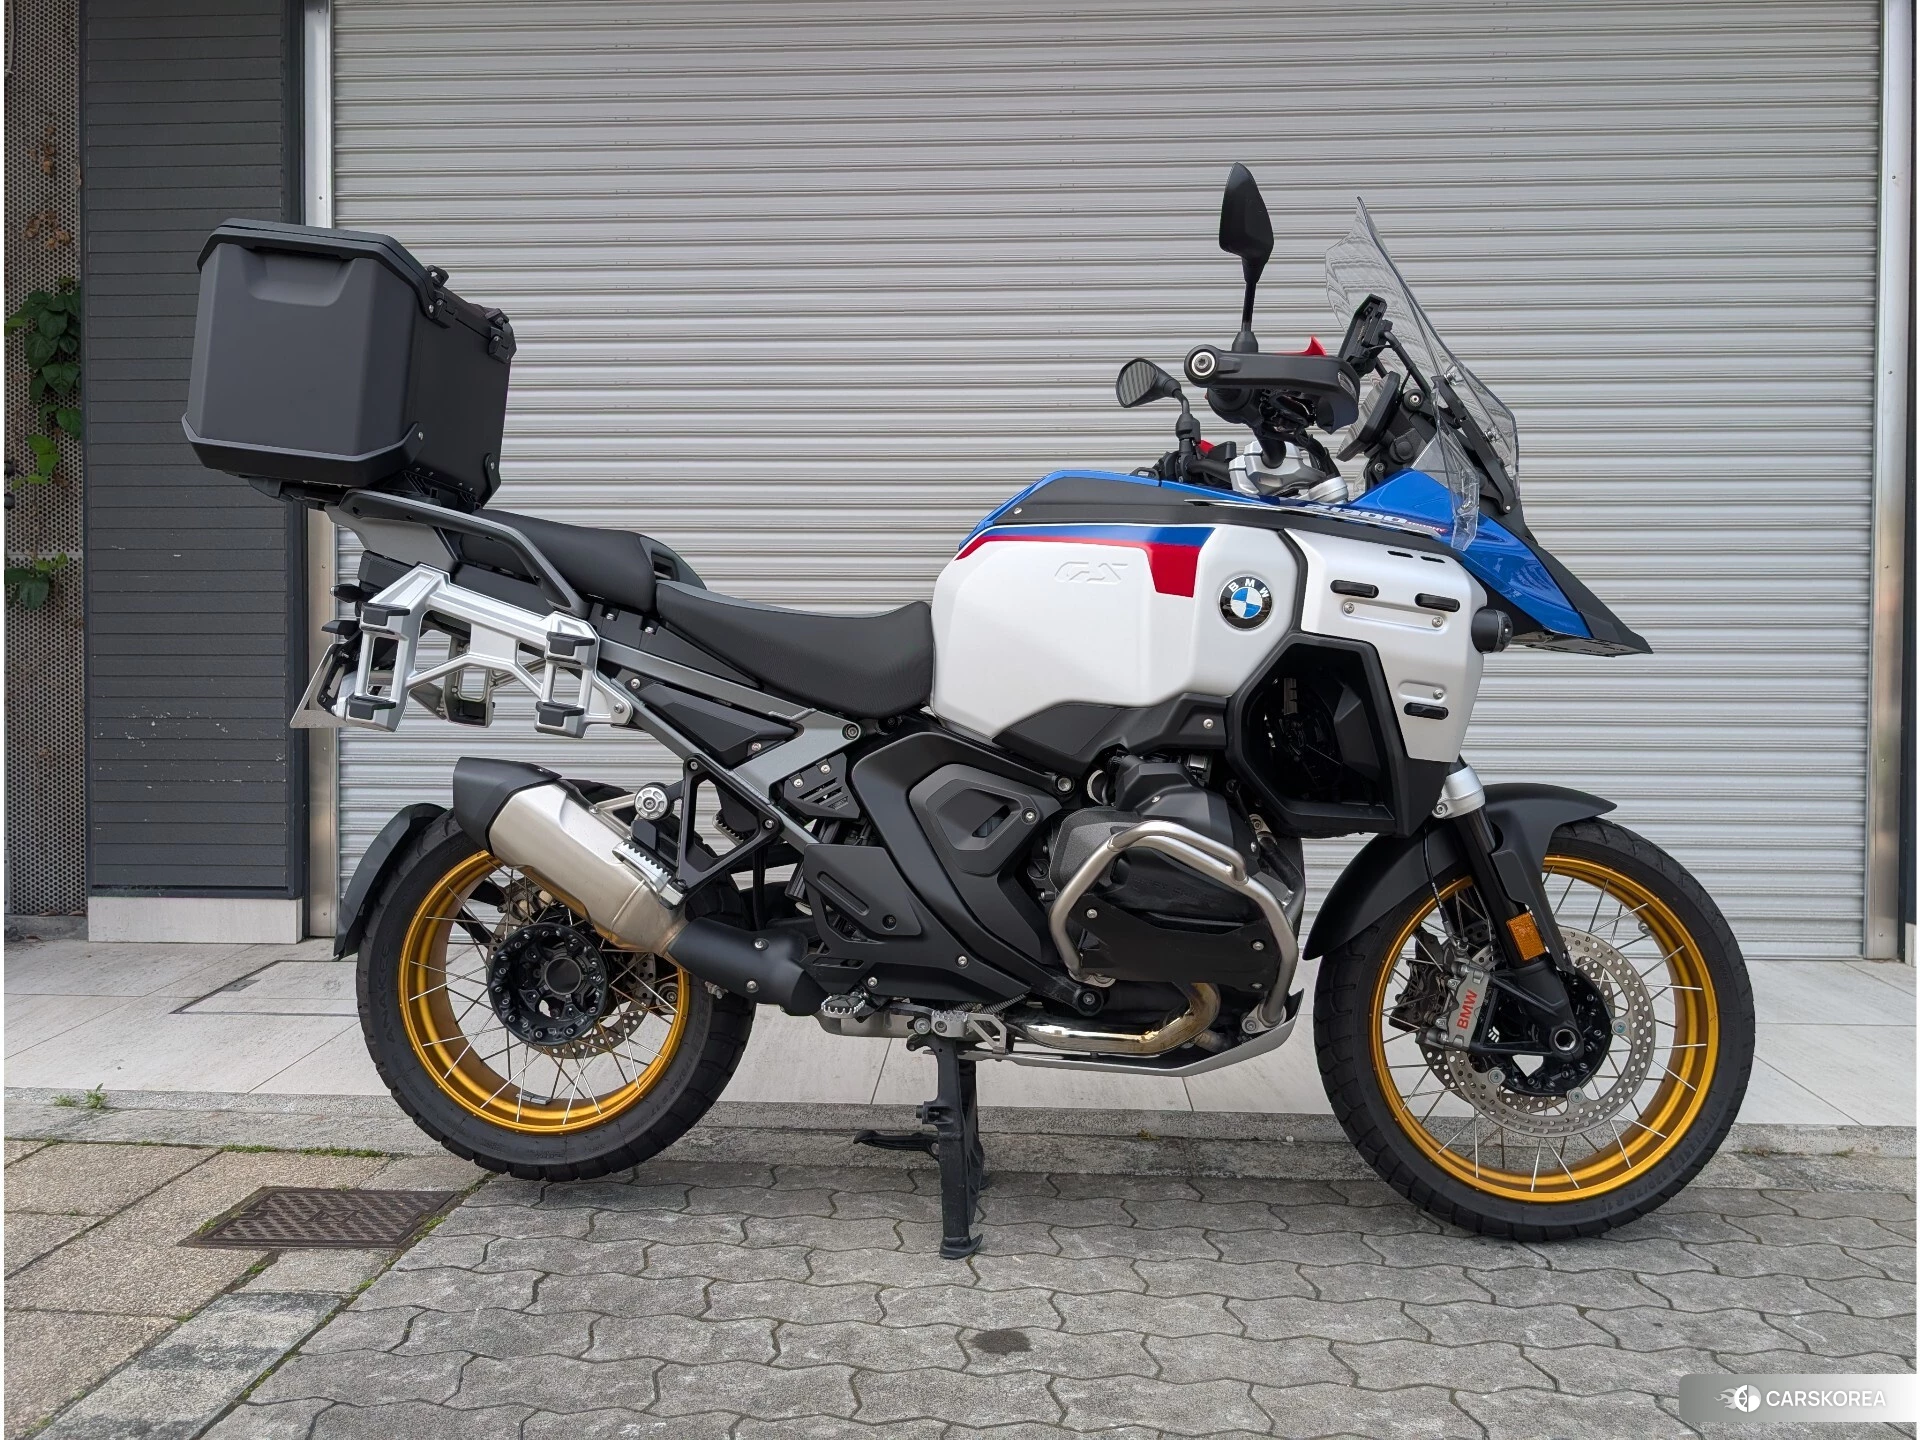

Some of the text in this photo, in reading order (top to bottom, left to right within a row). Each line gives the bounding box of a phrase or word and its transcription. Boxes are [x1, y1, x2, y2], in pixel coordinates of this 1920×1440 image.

[1054, 561, 1128, 585] GS
[1228, 577, 1270, 598] BMW
[1456, 989, 1478, 1030] BMW
